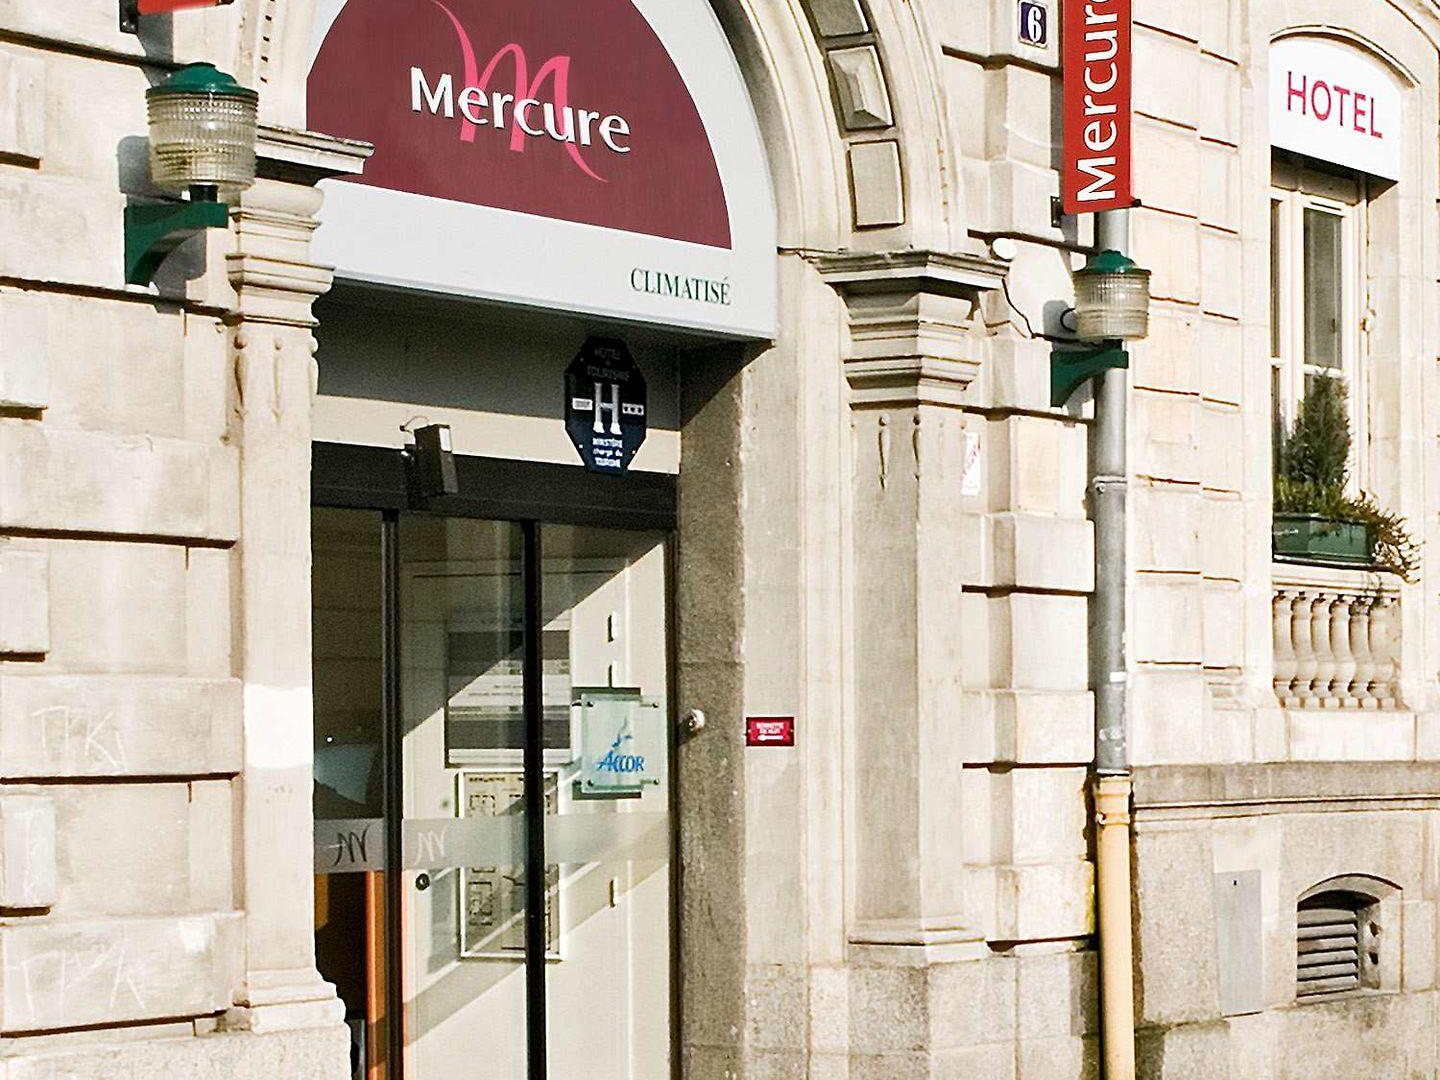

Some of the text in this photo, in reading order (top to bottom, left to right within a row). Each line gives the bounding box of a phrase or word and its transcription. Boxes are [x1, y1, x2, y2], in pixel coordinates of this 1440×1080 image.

[1027, 5, 1043, 43] 6
[410, 66, 632, 154] Mercure
[1287, 70, 1383, 139] HOTEL
[630, 267, 733, 307] CLIMATISÉ
[592, 382, 622, 435] H
[596, 750, 645, 773] ACCOR
